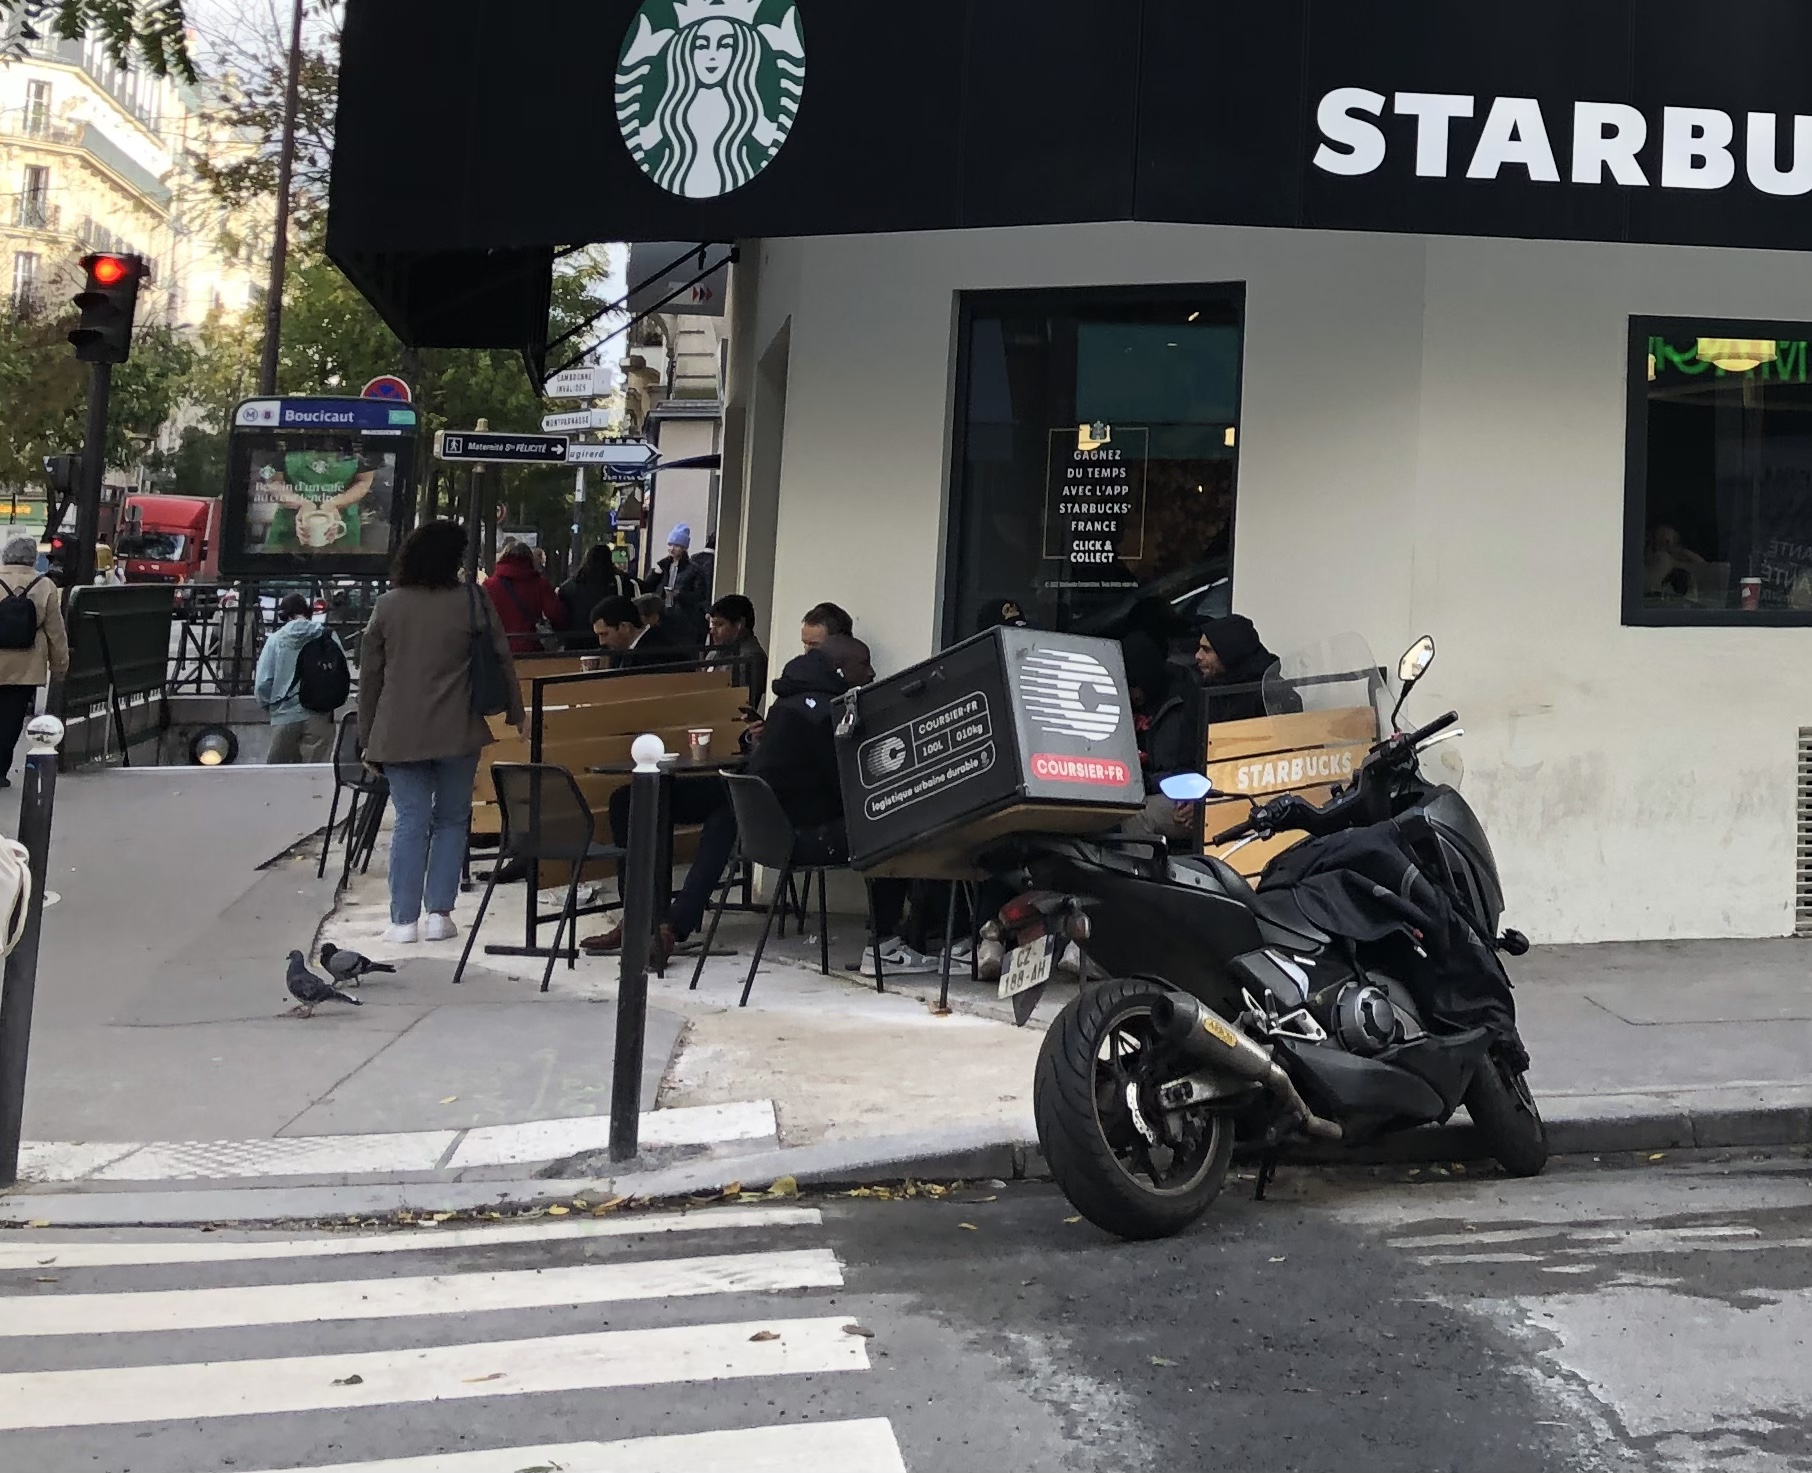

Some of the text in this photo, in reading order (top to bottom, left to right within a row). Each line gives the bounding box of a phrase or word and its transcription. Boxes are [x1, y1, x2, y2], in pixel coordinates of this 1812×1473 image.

[556, 372, 592, 383] CAMBRONNE
[284, 409, 355, 423] Boucicaut
[545, 415, 590, 427] MONTPARNASSE
[467, 441, 503, 452] Maternité
[516, 442, 547, 454] FÉLICITÉ
[569, 449, 605, 460] ugirard
[1073, 449, 1122, 461] GAGNEZ
[1066, 467, 1127, 479] DU TEMPS
[1062, 485, 1129, 496] AVEC L'APP
[1071, 520, 1117, 532] FRANCE
[1072, 540, 1113, 551] CLICK &
[1070, 552, 1115, 563] COLLECT
[922, 739, 944, 757] 100L
[1237, 751, 1352, 790] STARBUCKS
[871, 758, 979, 813] logistique urbaine durable
